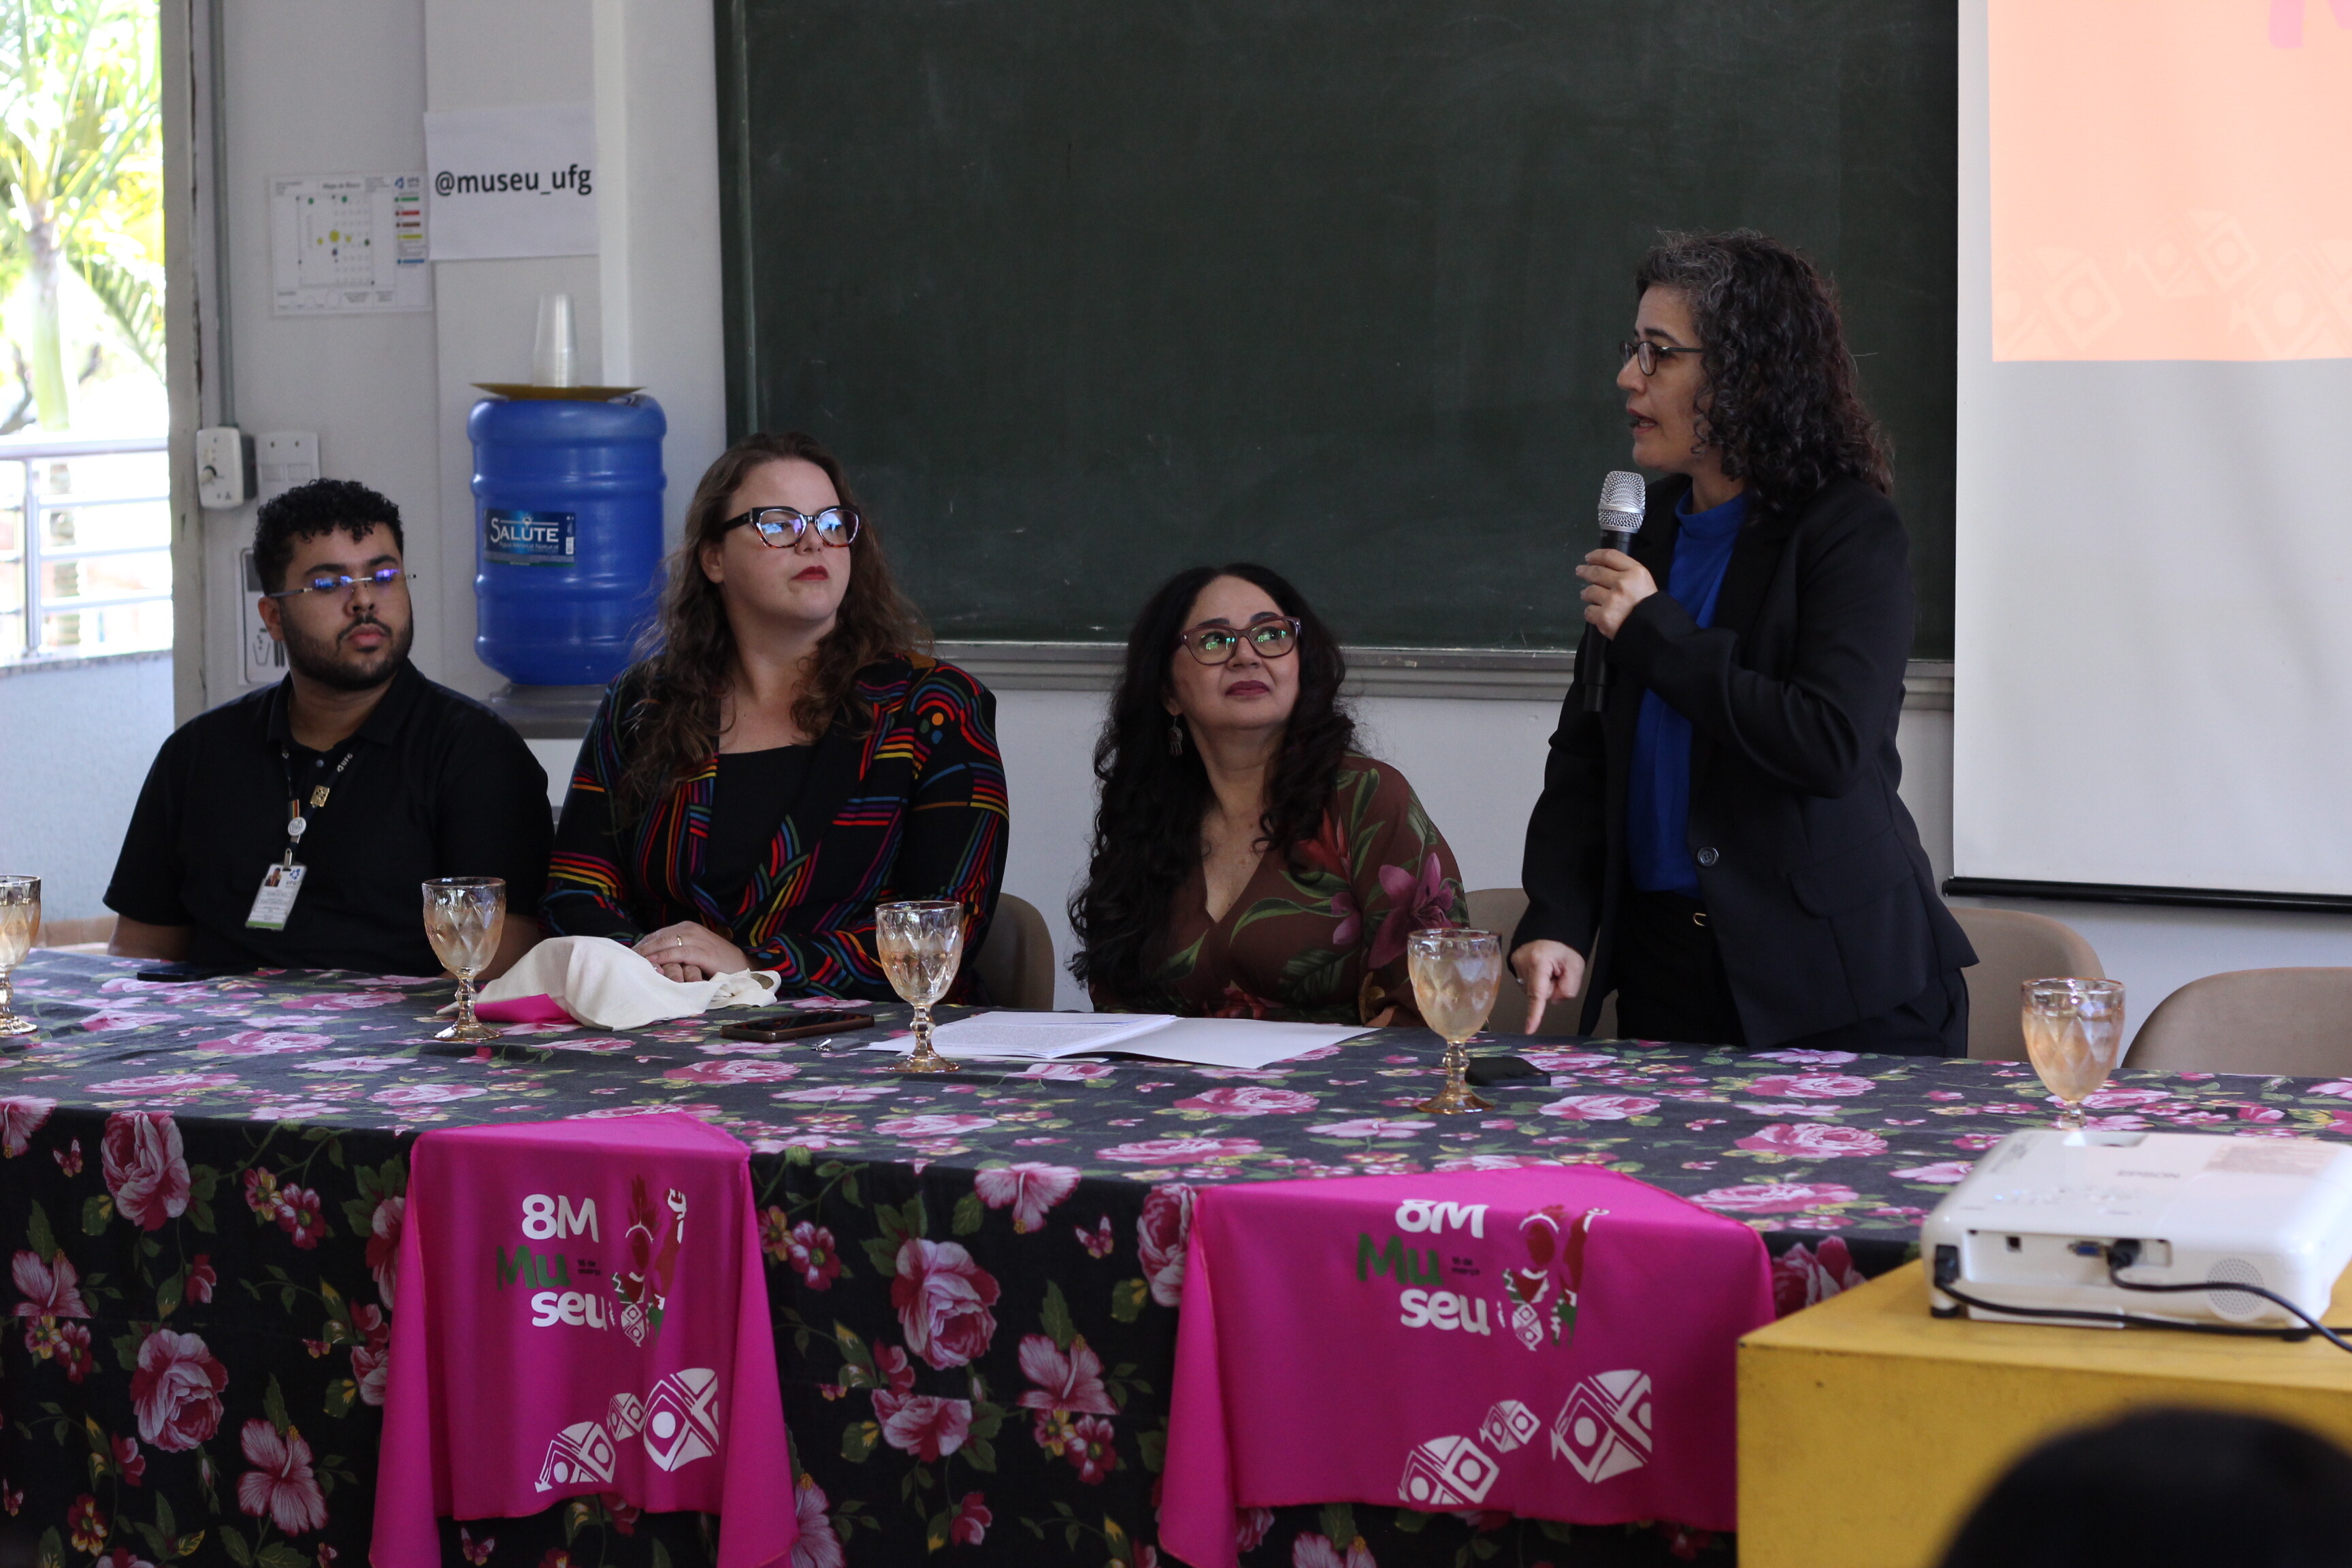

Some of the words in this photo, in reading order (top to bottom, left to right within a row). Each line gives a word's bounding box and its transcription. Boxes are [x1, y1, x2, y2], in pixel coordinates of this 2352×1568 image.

[436, 164, 591, 196] @museu_ufg
[490, 518, 559, 542] SALUTE
[341, 753, 353, 766] UFG
[521, 1194, 599, 1243] 8M
[1395, 1199, 1490, 1239] 8M
[497, 1245, 571, 1290] Mu
[1357, 1232, 1443, 1286] Mu
[531, 1292, 608, 1331] seu
[1400, 1288, 1491, 1336] seu
